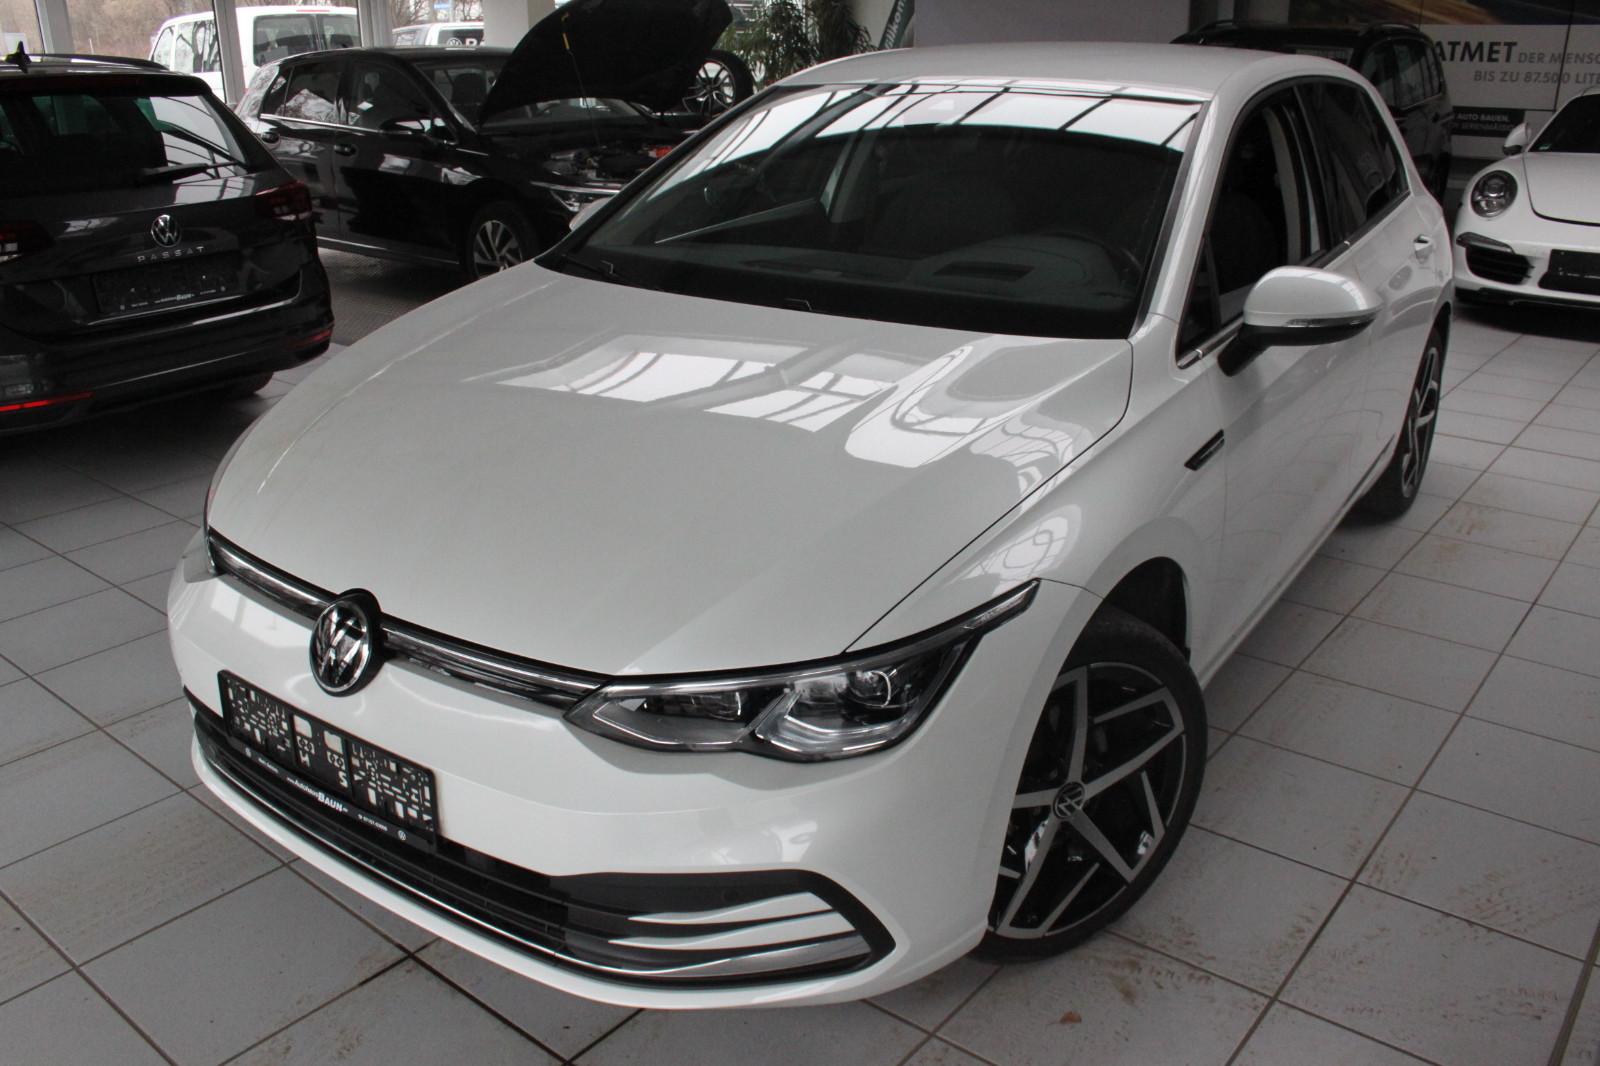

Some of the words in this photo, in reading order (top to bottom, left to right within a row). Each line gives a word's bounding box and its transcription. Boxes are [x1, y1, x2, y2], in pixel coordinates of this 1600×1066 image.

[1519, 52, 1546, 64] DER
[1474, 70, 1495, 82] BIS
[1500, 71, 1520, 82] ZU
[137, 246, 204, 262] PASSAT
